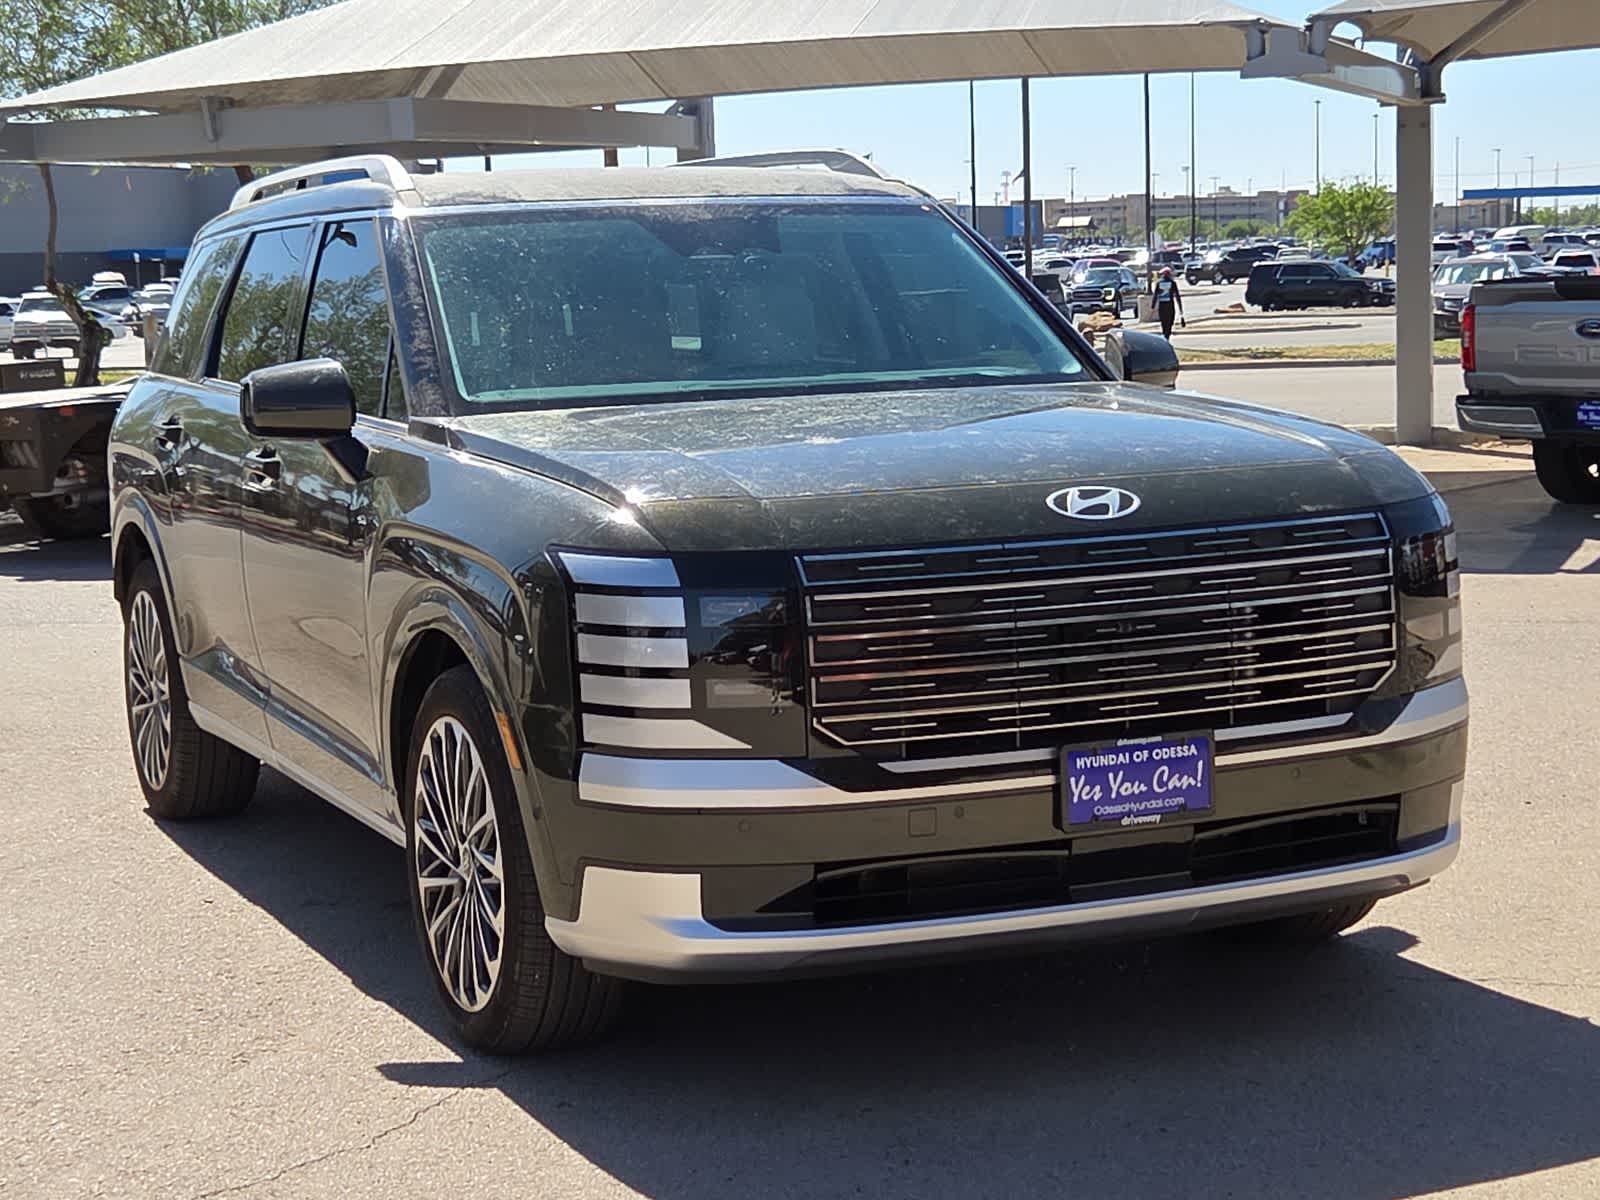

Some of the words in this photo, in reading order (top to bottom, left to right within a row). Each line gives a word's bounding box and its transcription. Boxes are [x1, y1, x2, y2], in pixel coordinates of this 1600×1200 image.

[1076, 751, 1130, 769] HYUNDAI
[1132, 750, 1149, 763] OF
[1152, 744, 1198, 760] ODESSA
[1069, 774, 1103, 804] Yes
[1108, 770, 1148, 799] You
[1152, 759, 1203, 793] Can!
